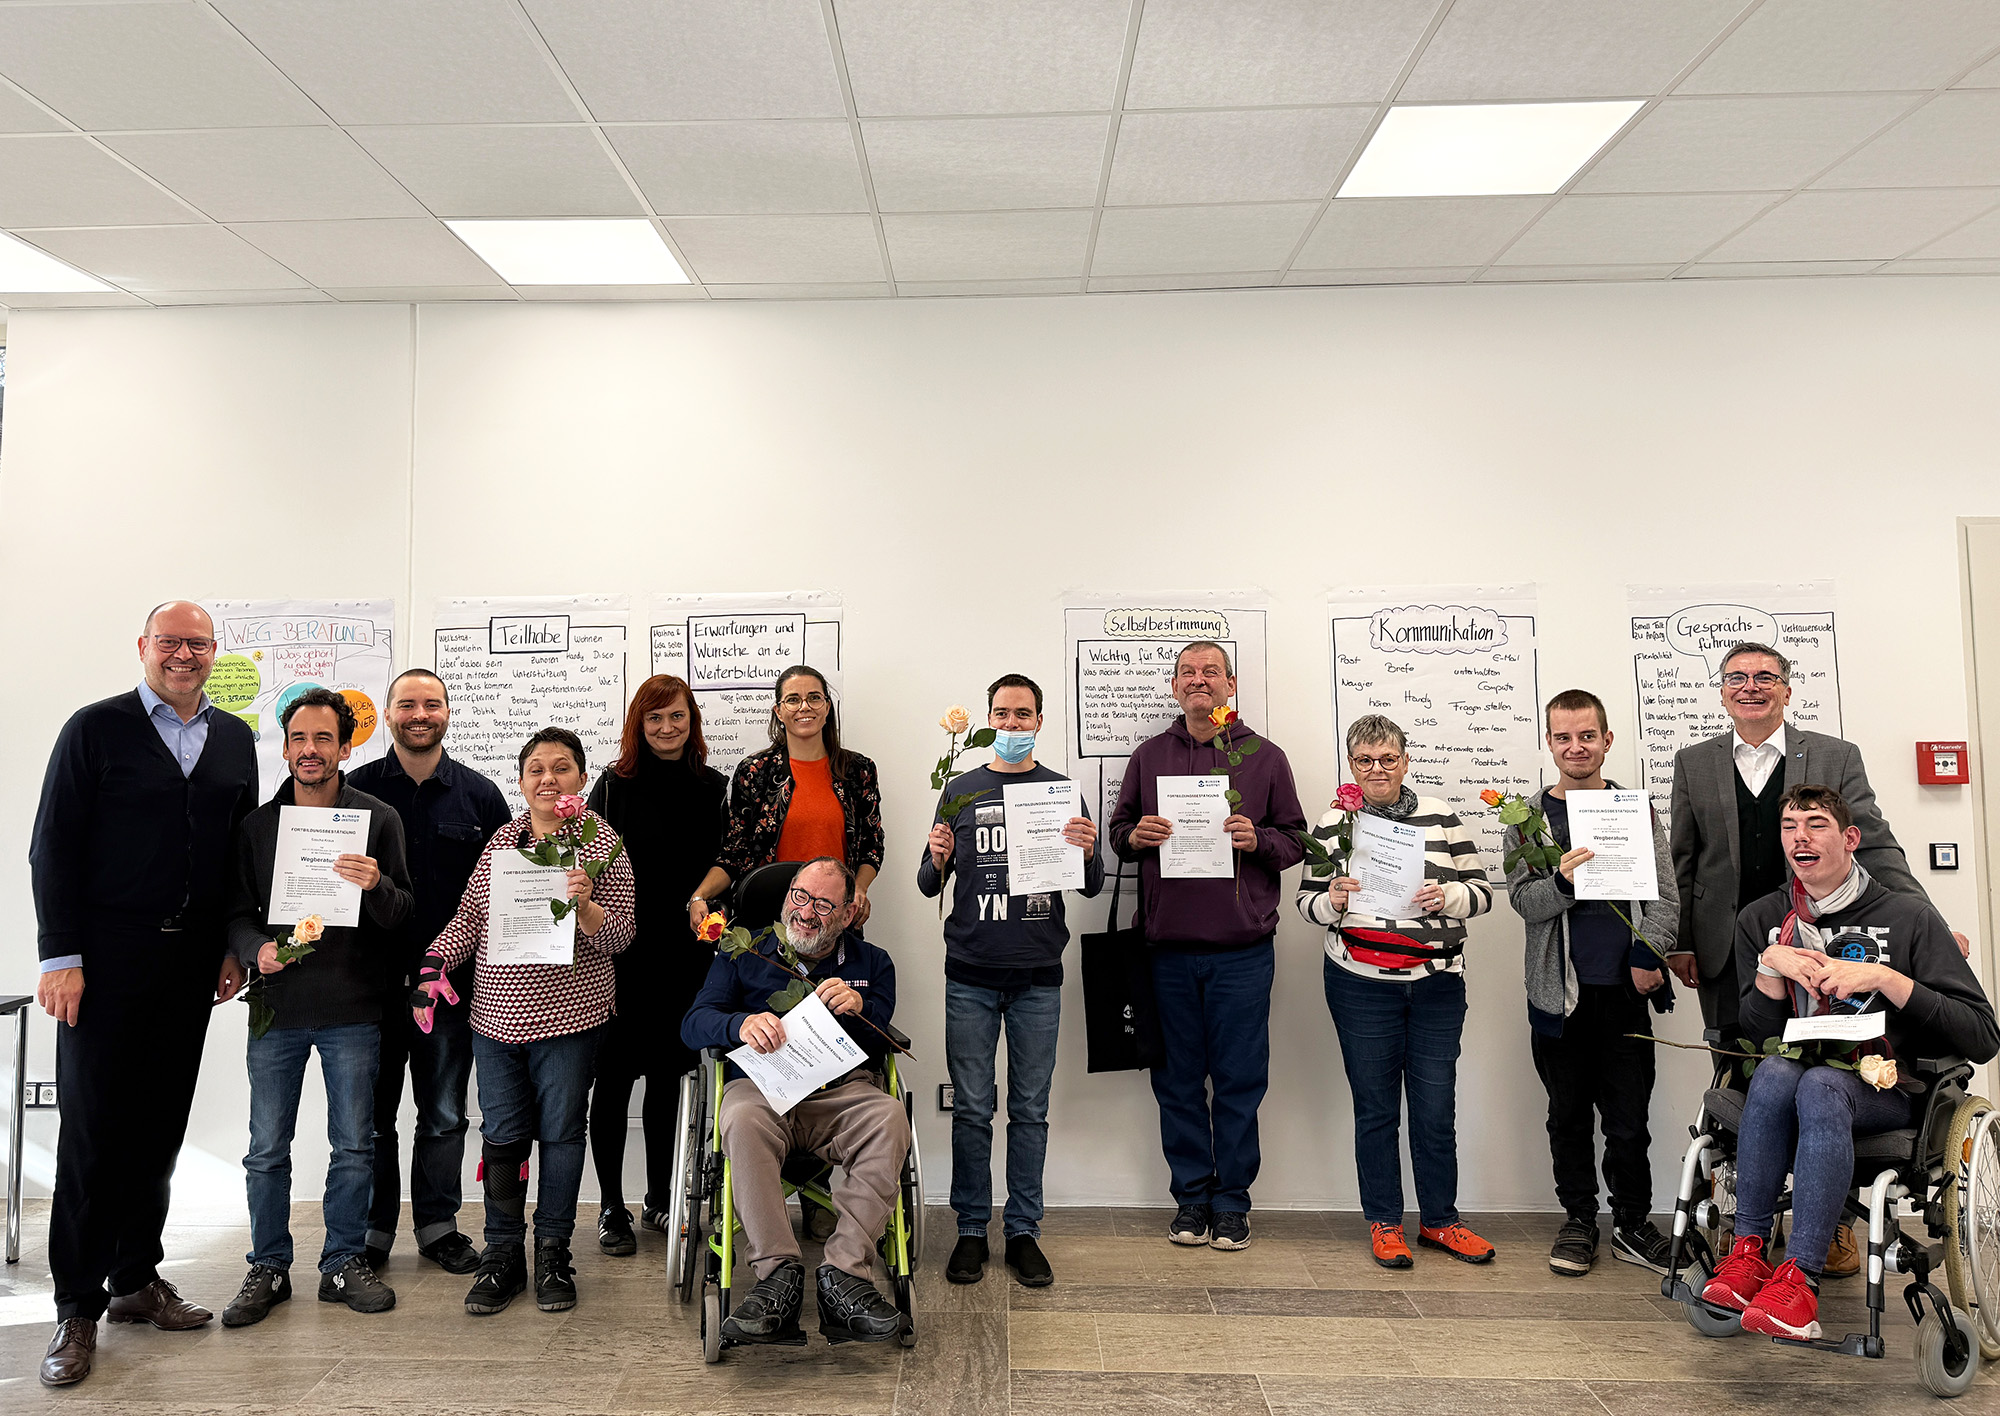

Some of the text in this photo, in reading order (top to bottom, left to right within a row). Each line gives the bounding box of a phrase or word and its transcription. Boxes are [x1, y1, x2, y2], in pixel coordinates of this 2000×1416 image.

[694, 620, 794, 638] Erwartungen und
[1111, 615, 1222, 638] Selbstbestimmung
[1379, 615, 1494, 643] Kommunikation
[496, 622, 562, 646] Teilhabe
[574, 635, 602, 643] Wohnen
[1646, 632, 1665, 642] Anfang
[1783, 636, 1819, 648] Umgebung
[276, 648, 333, 663] Was gehört
[566, 650, 615, 661] Handy Disco
[694, 642, 791, 659] Wünsche an die
[1089, 647, 1179, 665] Wichtig für Rats
[460, 659, 482, 668] dabei
[485, 659, 502, 668] sein
[1338, 653, 1520, 664] Post E-Mail
[512, 669, 567, 681] Unterstützung
[580, 665, 597, 673] Chor
[1083, 668, 1097, 676] Was
[1385, 661, 1501, 676] Briefe unterhalten
[448, 682, 593, 697] den Bus kommen Zugeständnisse
[1641, 679, 1654, 689] Wie
[552, 699, 606, 712] Wertschätzung
[1369, 697, 1512, 715] hören Fragen stellen
[1404, 690, 1433, 710] Handy
[1801, 699, 1820, 709] Zeit
[508, 707, 531, 716] Kultur
[549, 714, 581, 724] Freizeit
[1513, 714, 1532, 723] hören
[1793, 710, 1818, 720] Raum
[493, 718, 615, 730] Begegnungen Geld
[715, 718, 740, 726] erklären
[1414, 718, 1438, 726] SMS
[574, 728, 600, 737] Rente
[1645, 727, 1675, 740] Fragen
[445, 744, 496, 754] esellschaft
[1647, 743, 1673, 752] Tonart
